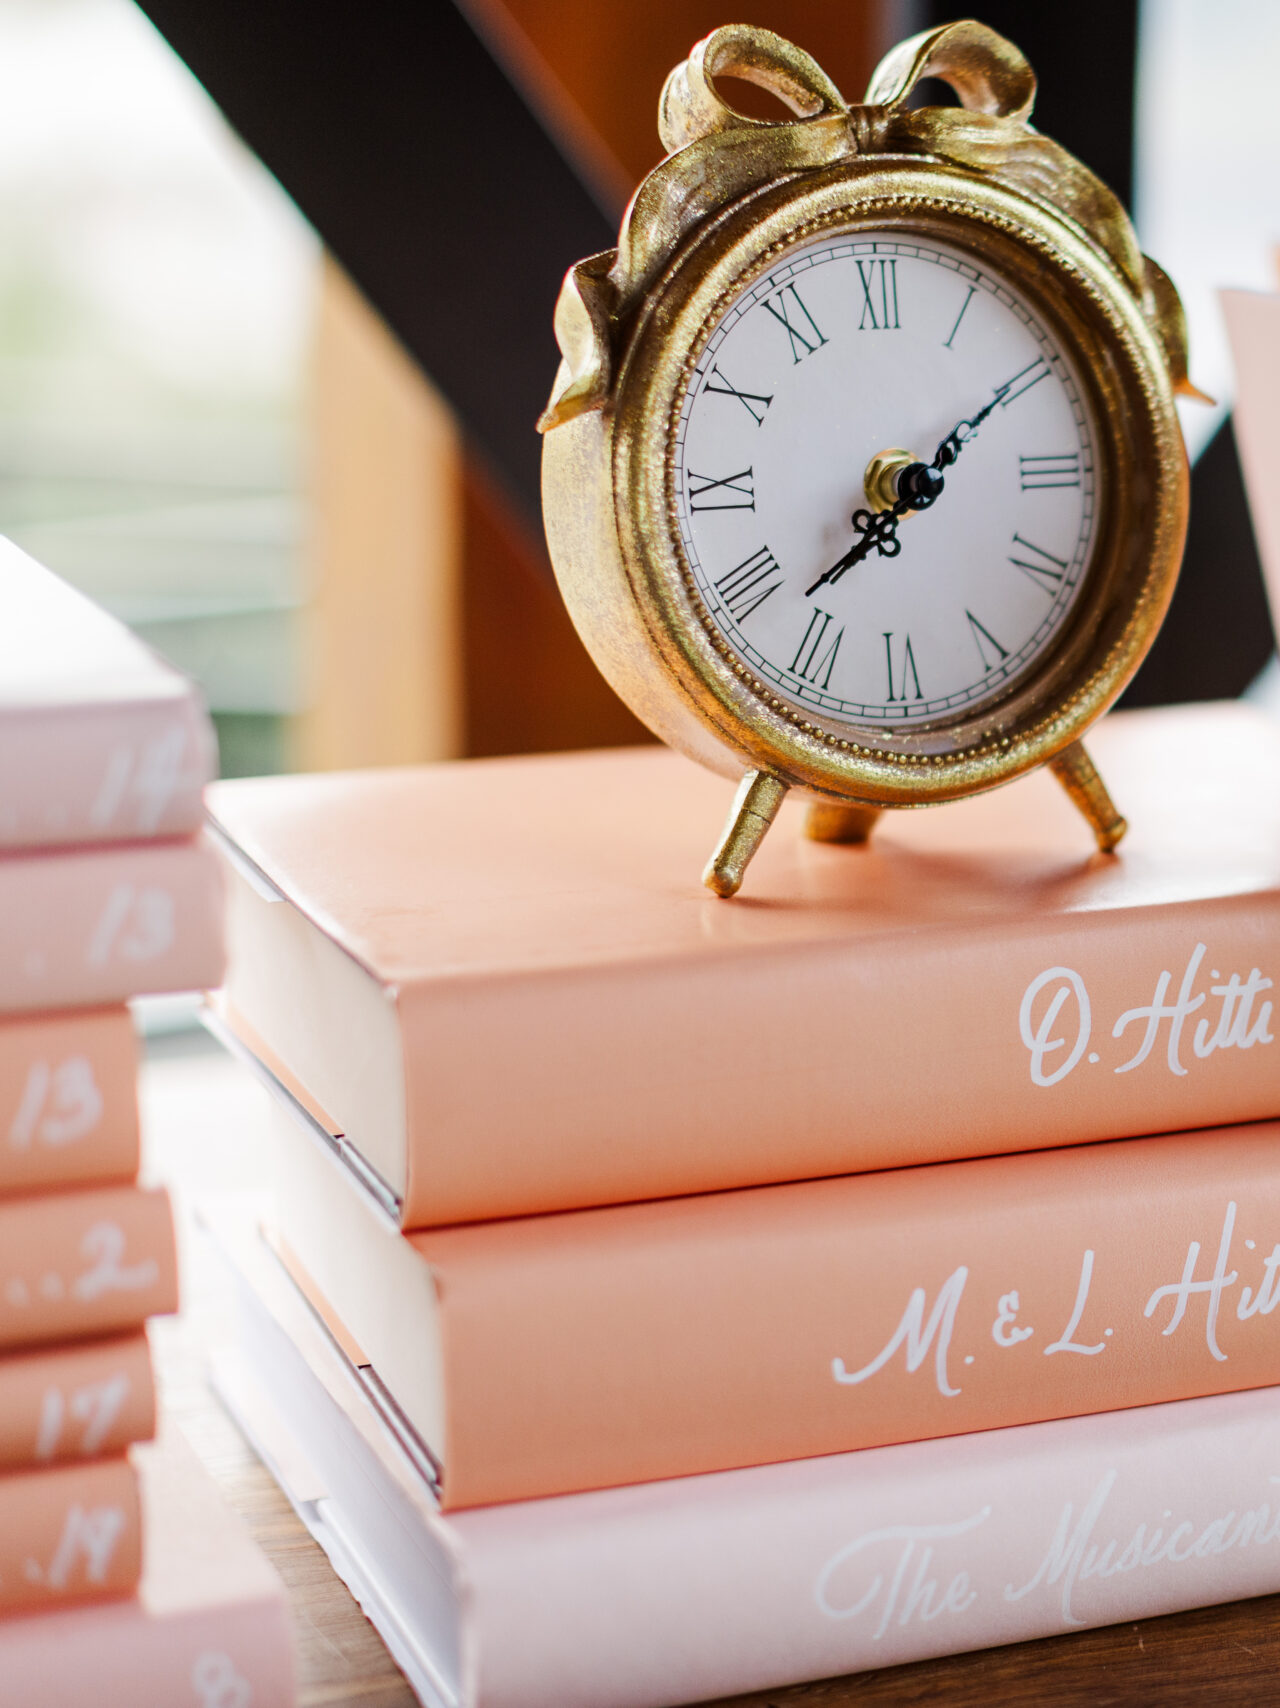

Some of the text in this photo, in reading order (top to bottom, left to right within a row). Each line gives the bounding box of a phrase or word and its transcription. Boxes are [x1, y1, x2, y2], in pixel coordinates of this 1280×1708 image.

[761, 282, 830, 365] XI
[855, 259, 902, 330] XII
[703, 363, 774, 427] X
[687, 466, 756, 515] IX
[1019, 453, 1080, 491] III
[713, 545, 785, 625] VIII
[1007, 533, 1069, 597] IV
[787, 607, 845, 690] VII
[883, 633, 925, 701] VI
[965, 608, 1010, 672] V
[8, 1055, 103, 1151] 13
[992, 1290, 1034, 1346] &
[812, 1504, 993, 1641] The
